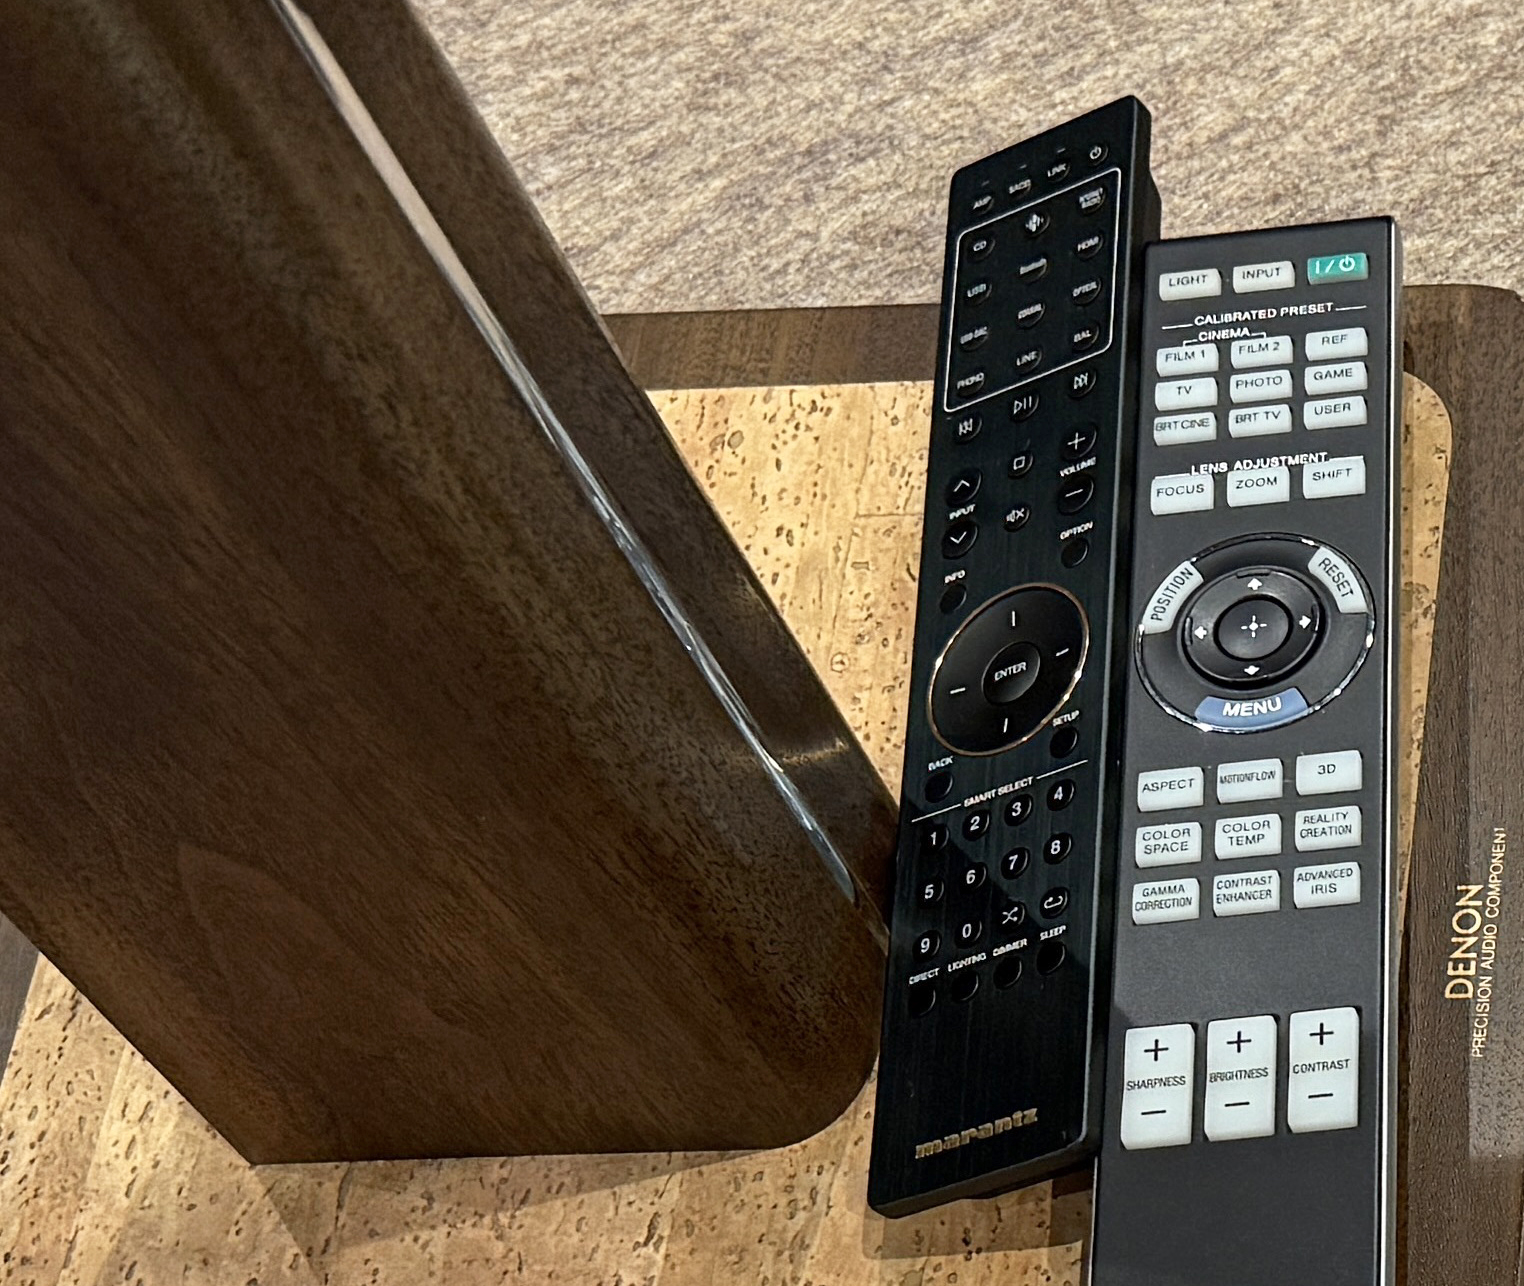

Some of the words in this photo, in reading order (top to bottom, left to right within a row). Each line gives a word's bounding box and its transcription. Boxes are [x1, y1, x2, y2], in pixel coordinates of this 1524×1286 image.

[1169, 274, 1207, 287] LIGHT
[1242, 268, 1281, 279] INPUT
[1194, 309, 1277, 326] CALIBRATED
[1280, 303, 1334, 317] PRESET
[1198, 328, 1250, 341] CINEMA
[1017, 351, 1038, 366] LINE
[1314, 369, 1353, 381] GAME
[1236, 376, 1283, 389] PHOTO
[1314, 403, 1351, 415] USER
[1191, 462, 1228, 476] LENS
[1234, 452, 1328, 472] ADJUSTMENT
[1312, 469, 1353, 481] SHIFT
[1157, 484, 1205, 497] FOCUS
[1236, 477, 1278, 490] ZOOM
[950, 504, 975, 520] INPUT
[1060, 521, 1094, 540] OPTION
[1318, 557, 1353, 598] RESET
[1151, 568, 1194, 622] POSITION
[994, 662, 1027, 681] ENTER
[1223, 697, 1282, 717] MENU
[1317, 764, 1336, 775] 3D
[998, 776, 1033, 796] SELECT
[1054, 786, 1063, 800] 4
[1142, 779, 1195, 793] ASPECT
[1012, 801, 1021, 816] 3
[970, 816, 980, 830] 2
[1222, 820, 1271, 834] COLOR
[1142, 828, 1191, 841] COLOR
[1300, 825, 1352, 839] CREATION
[1051, 839, 1060, 853] 8
[1228, 833, 1265, 846] TEMP
[1144, 841, 1189, 855] SPACE
[1297, 868, 1353, 882] ADVANCED
[1485, 827, 1507, 918] COMPONENT
[1217, 876, 1273, 890] CONTRAST
[1142, 884, 1185, 897] GAMMA
[1445, 884, 1484, 1000] DENON
[1481, 923, 1497, 970] AUDIO
[1471, 976, 1492, 1057] PRECISION
[1293, 1059, 1350, 1074] CONTRAST
[915, 1107, 1038, 1159] marantz
